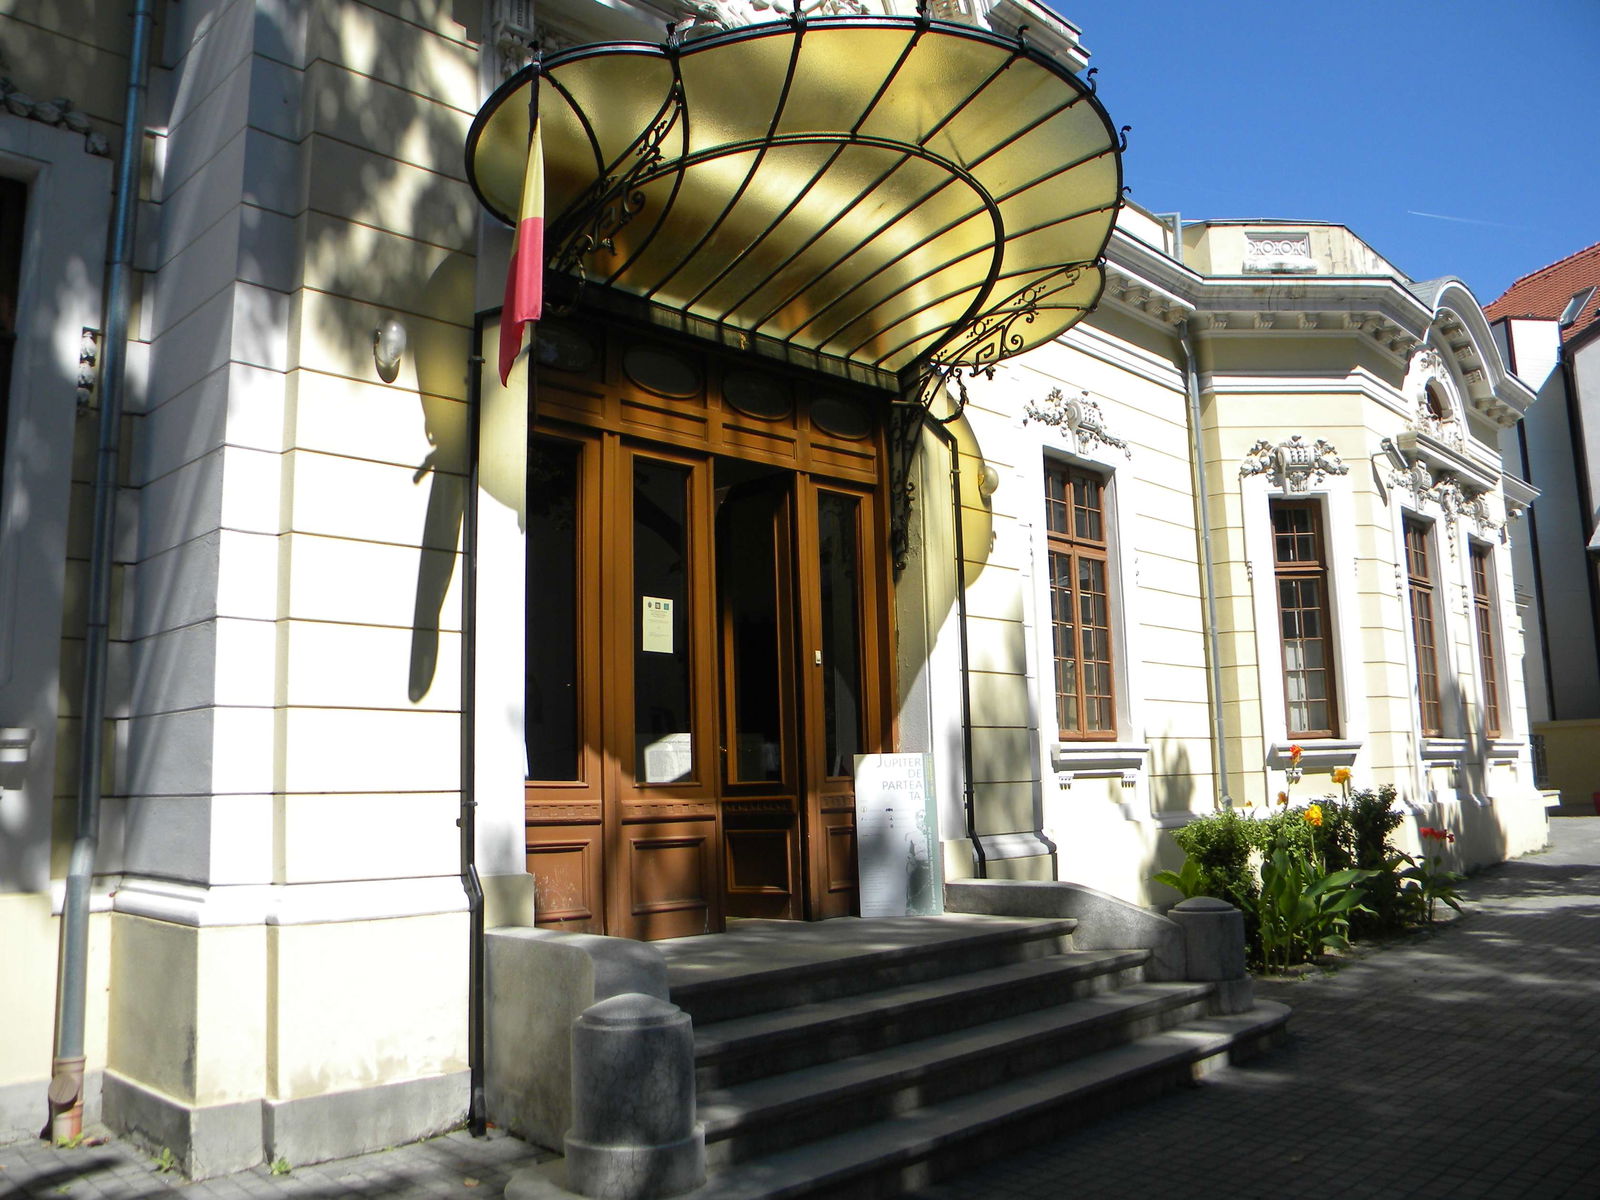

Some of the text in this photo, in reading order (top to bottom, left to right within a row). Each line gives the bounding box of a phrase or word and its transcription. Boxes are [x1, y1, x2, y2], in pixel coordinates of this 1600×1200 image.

[876, 753, 921, 768] JUPITER
[908, 769, 921, 779] DE
[882, 780, 923, 791] PARTEA
[908, 791, 921, 801] TA
